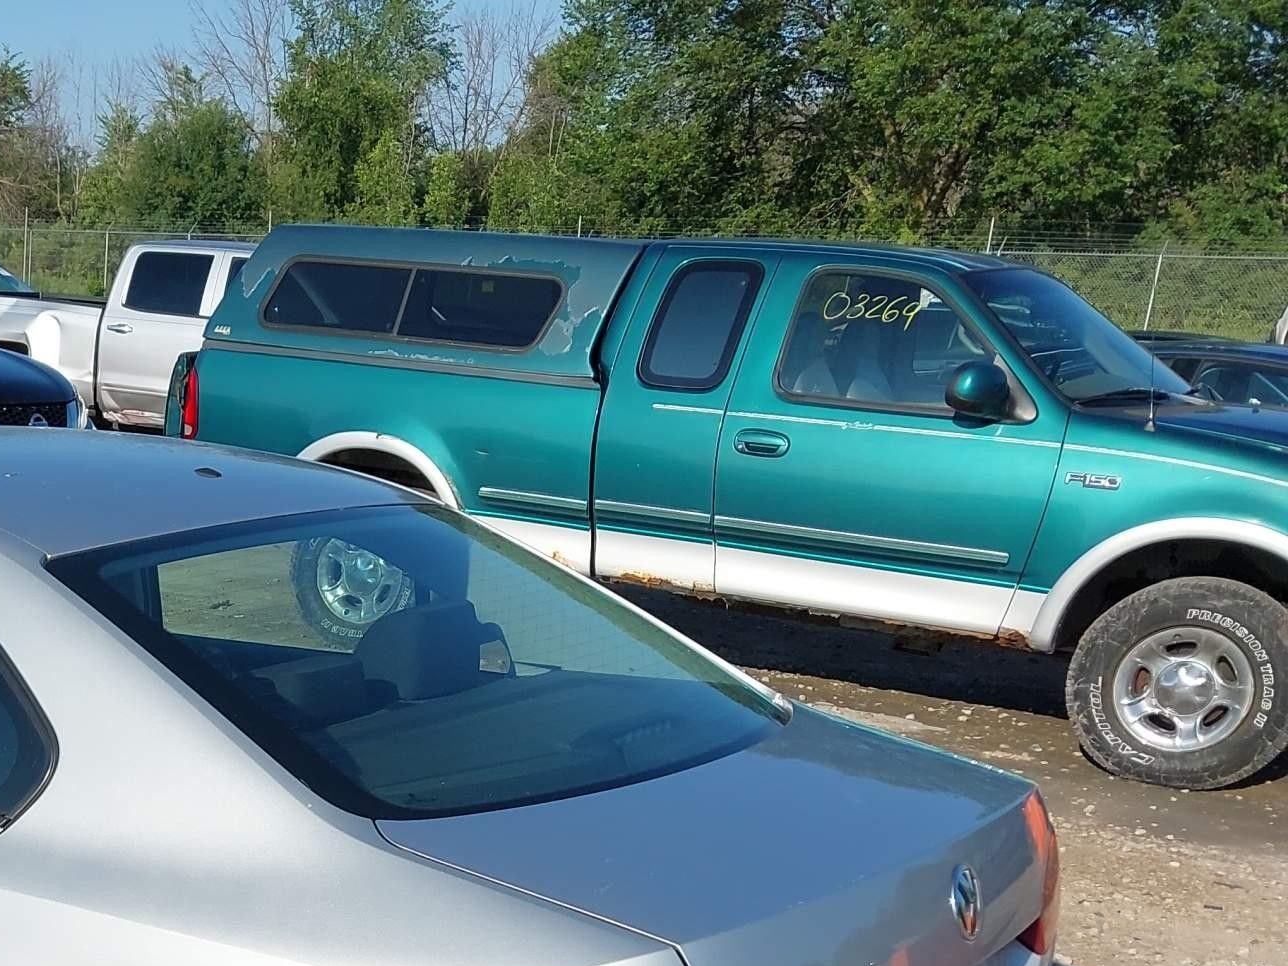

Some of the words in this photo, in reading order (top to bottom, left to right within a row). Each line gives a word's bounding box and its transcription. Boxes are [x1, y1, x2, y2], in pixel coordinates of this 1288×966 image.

[823, 291, 921, 331] 03269
[1186, 608, 1269, 662] PRECISION
[1260, 663, 1274, 711] TRAC
[1090, 675, 1155, 765] CAPITOL
